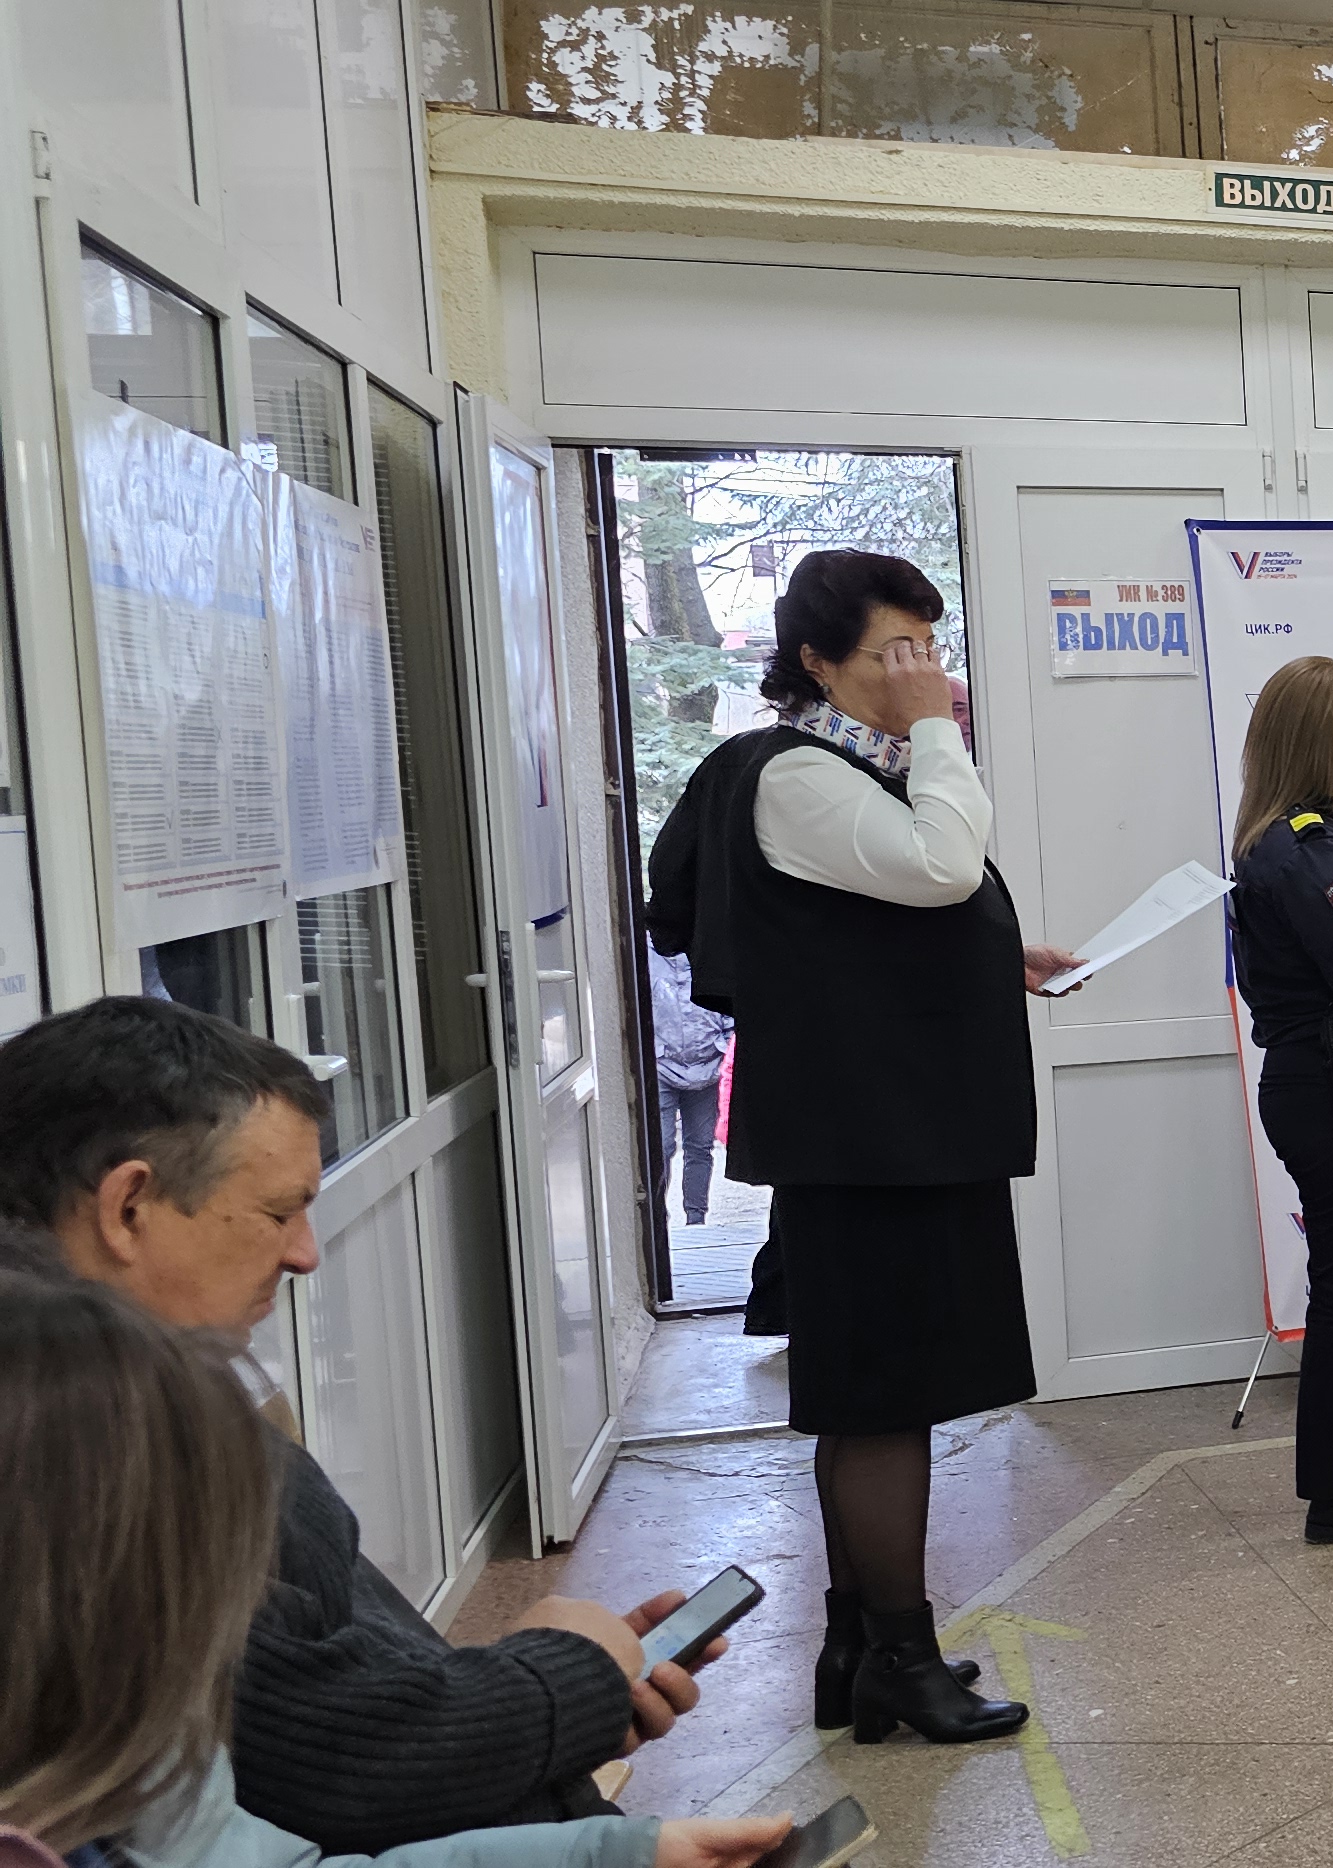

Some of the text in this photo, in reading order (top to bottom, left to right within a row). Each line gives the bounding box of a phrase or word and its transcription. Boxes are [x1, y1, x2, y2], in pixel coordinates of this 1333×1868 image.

[1117, 585, 1185, 602] УИК № 389
[1056, 612, 1189, 656] ВЫХОД
[1245, 623, 1293, 636] ЦИК.РФ
